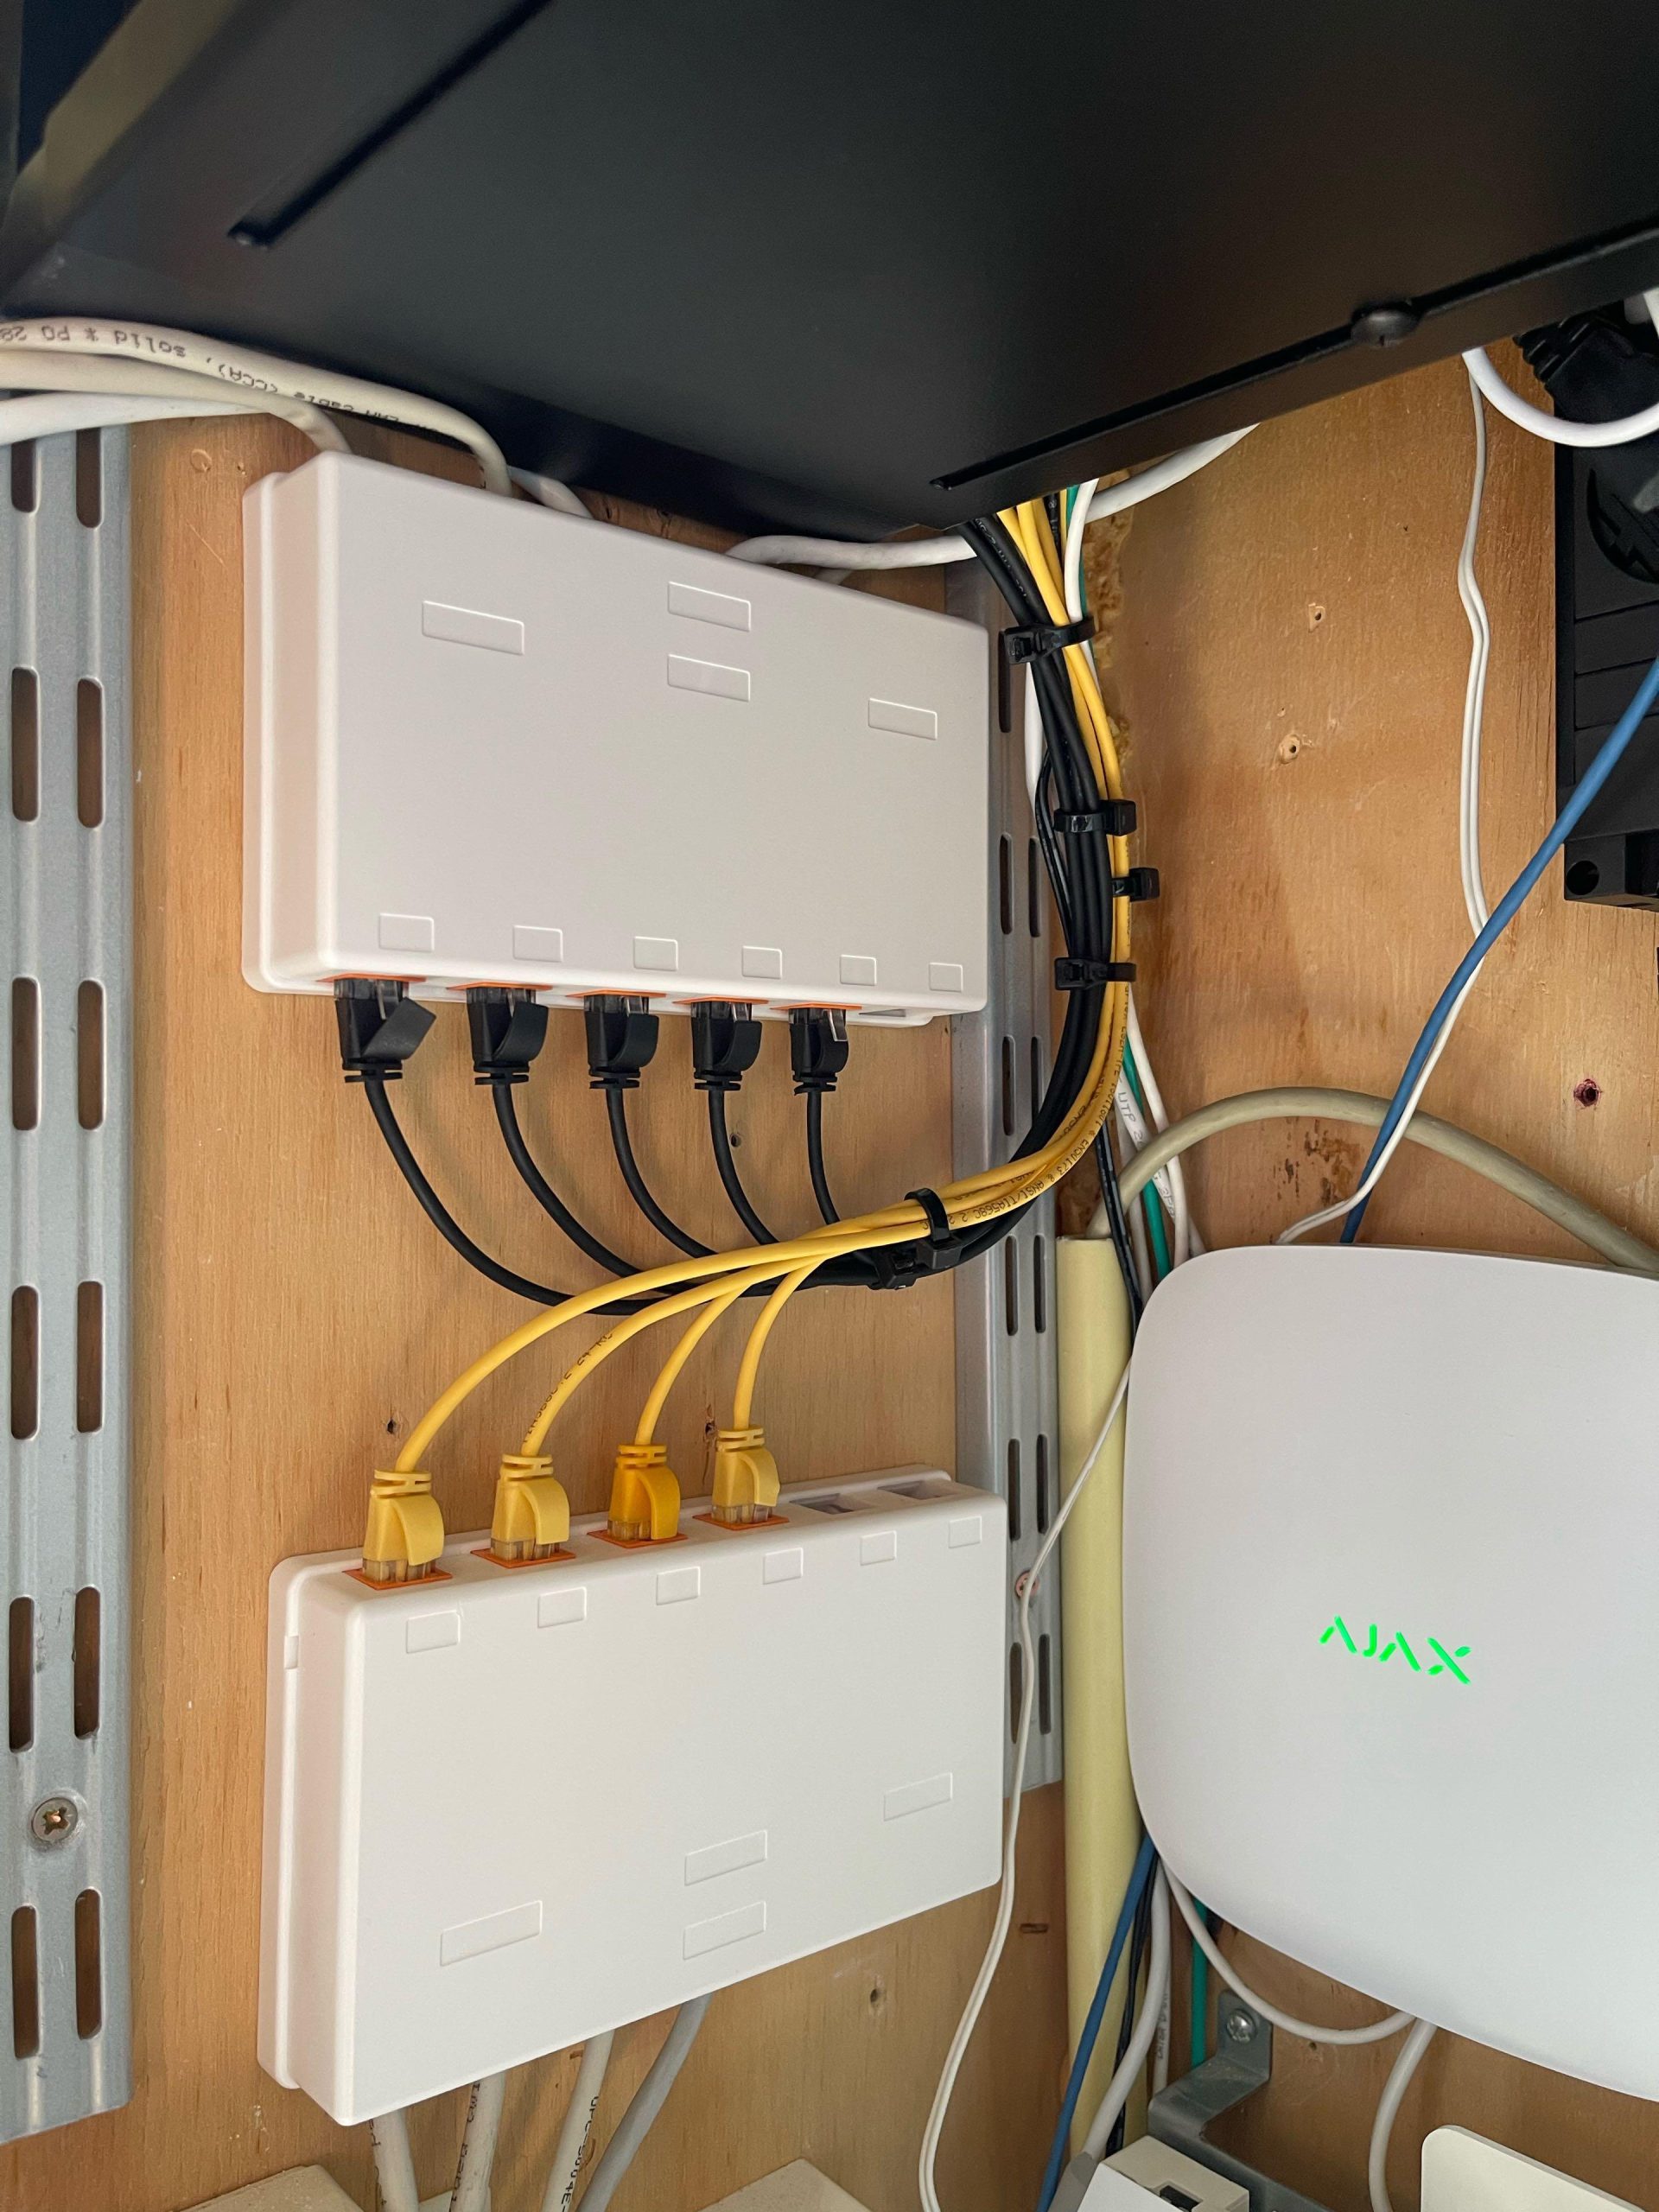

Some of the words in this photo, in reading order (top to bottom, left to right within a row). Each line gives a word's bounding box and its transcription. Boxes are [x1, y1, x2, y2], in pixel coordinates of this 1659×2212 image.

[114, 329, 186, 358] solid
[1117, 1090, 1136, 1123] UTP
[1319, 1614, 1471, 1685] AJAX
